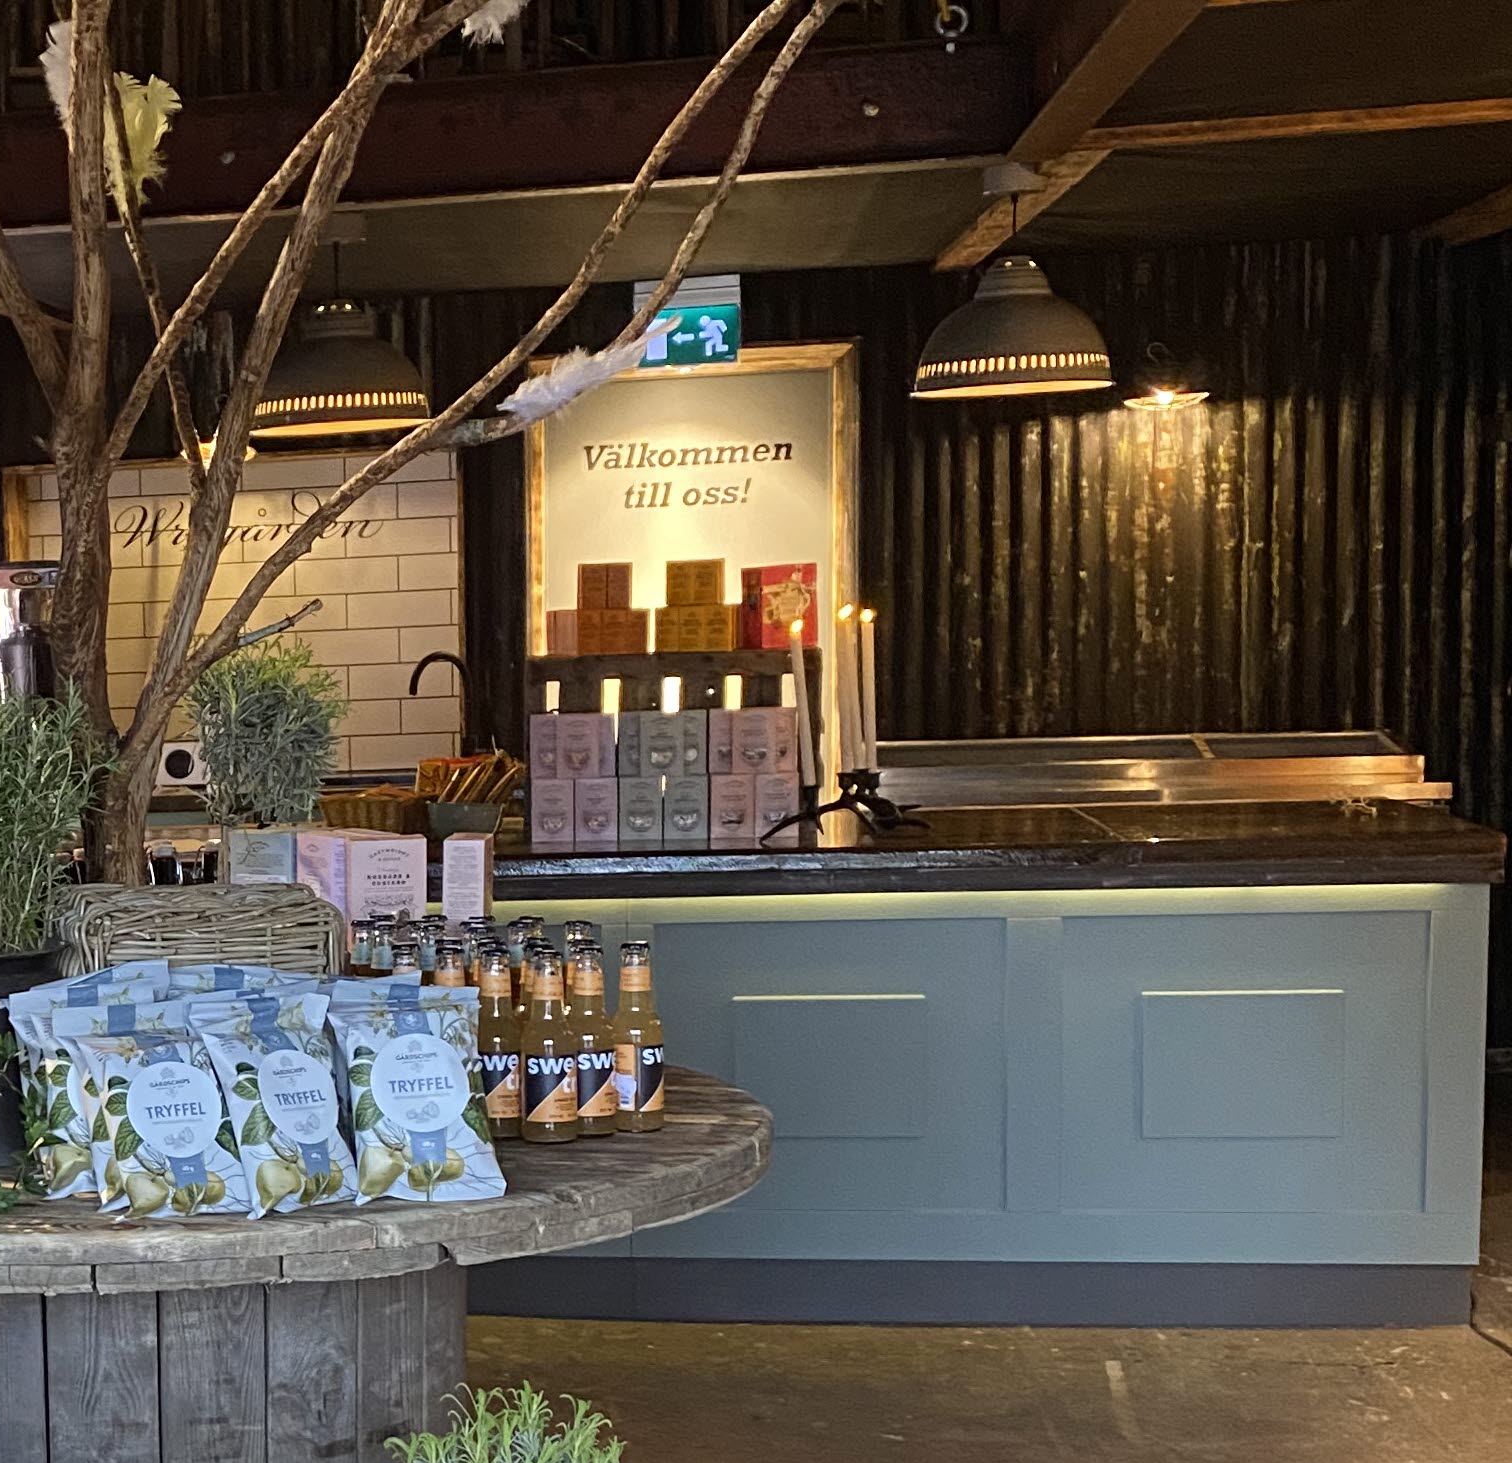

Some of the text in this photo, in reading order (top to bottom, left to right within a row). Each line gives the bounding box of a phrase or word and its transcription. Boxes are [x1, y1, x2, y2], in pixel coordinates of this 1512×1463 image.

[584, 442, 793, 471] Välkommen
[624, 478, 752, 509] till oss!
[389, 1076, 454, 1094] TRYFFEL
[274, 1089, 327, 1107] TRYFFEL
[145, 1101, 207, 1119] TRYFFEL
